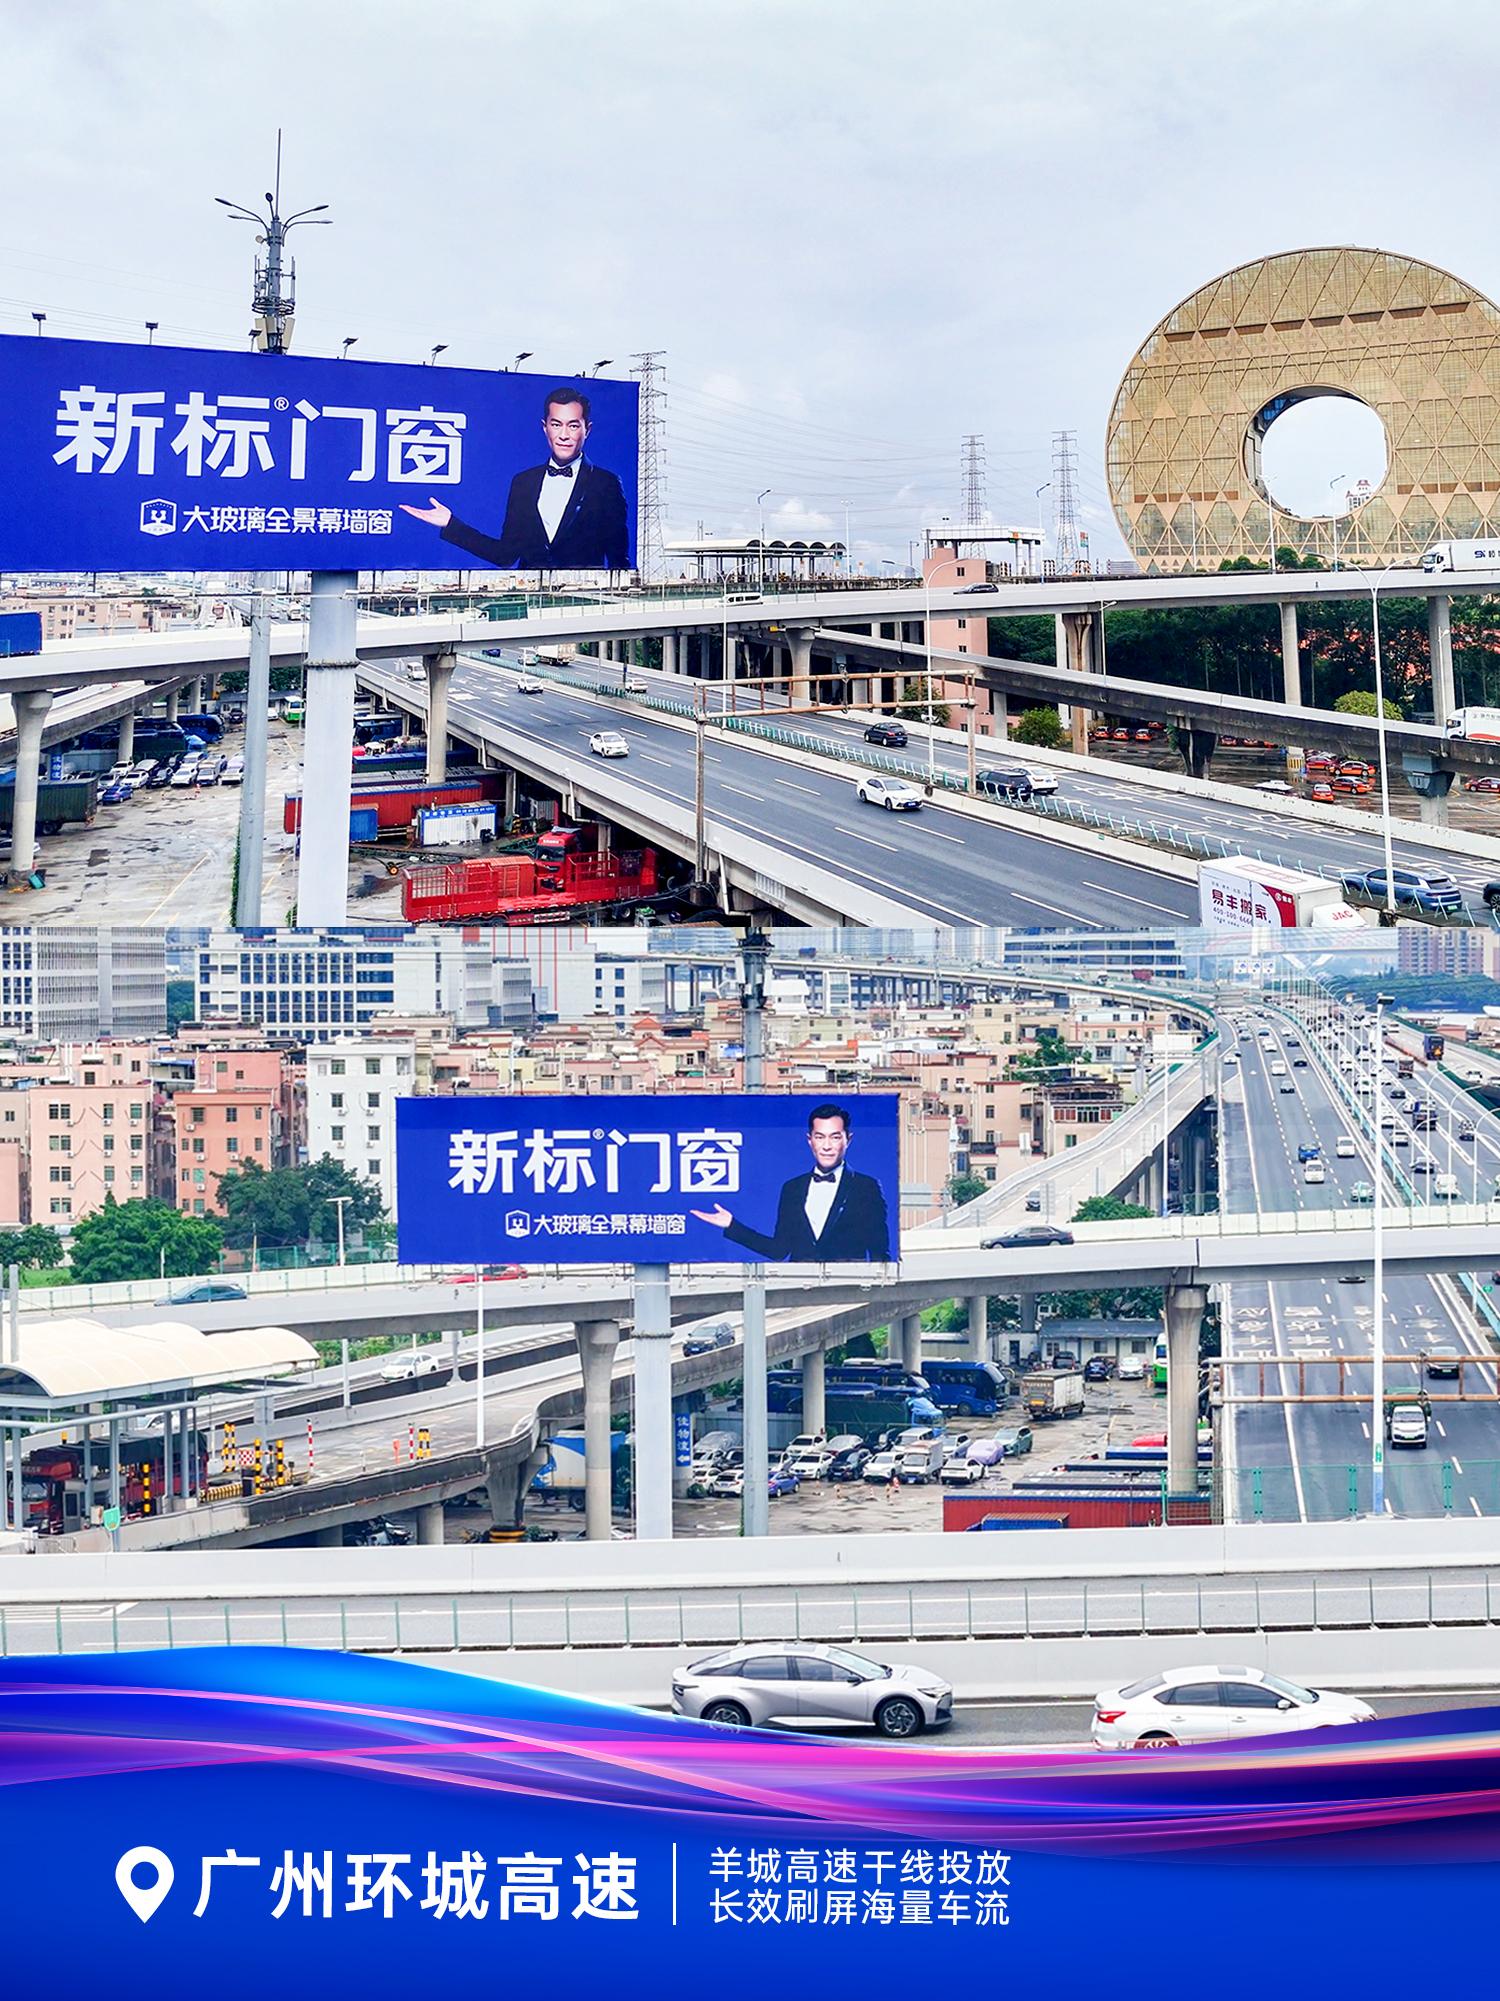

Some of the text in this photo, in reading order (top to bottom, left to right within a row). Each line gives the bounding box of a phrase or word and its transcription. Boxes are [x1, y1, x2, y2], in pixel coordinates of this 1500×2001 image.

[183, 505, 393, 534] 大玻璃全景幕墙窗
[1211, 888, 1267, 922] 易丰搬家
[1331, 910, 1353, 921] JAC
[533, 1214, 686, 1235] 大玻璃全景幕墙窗
